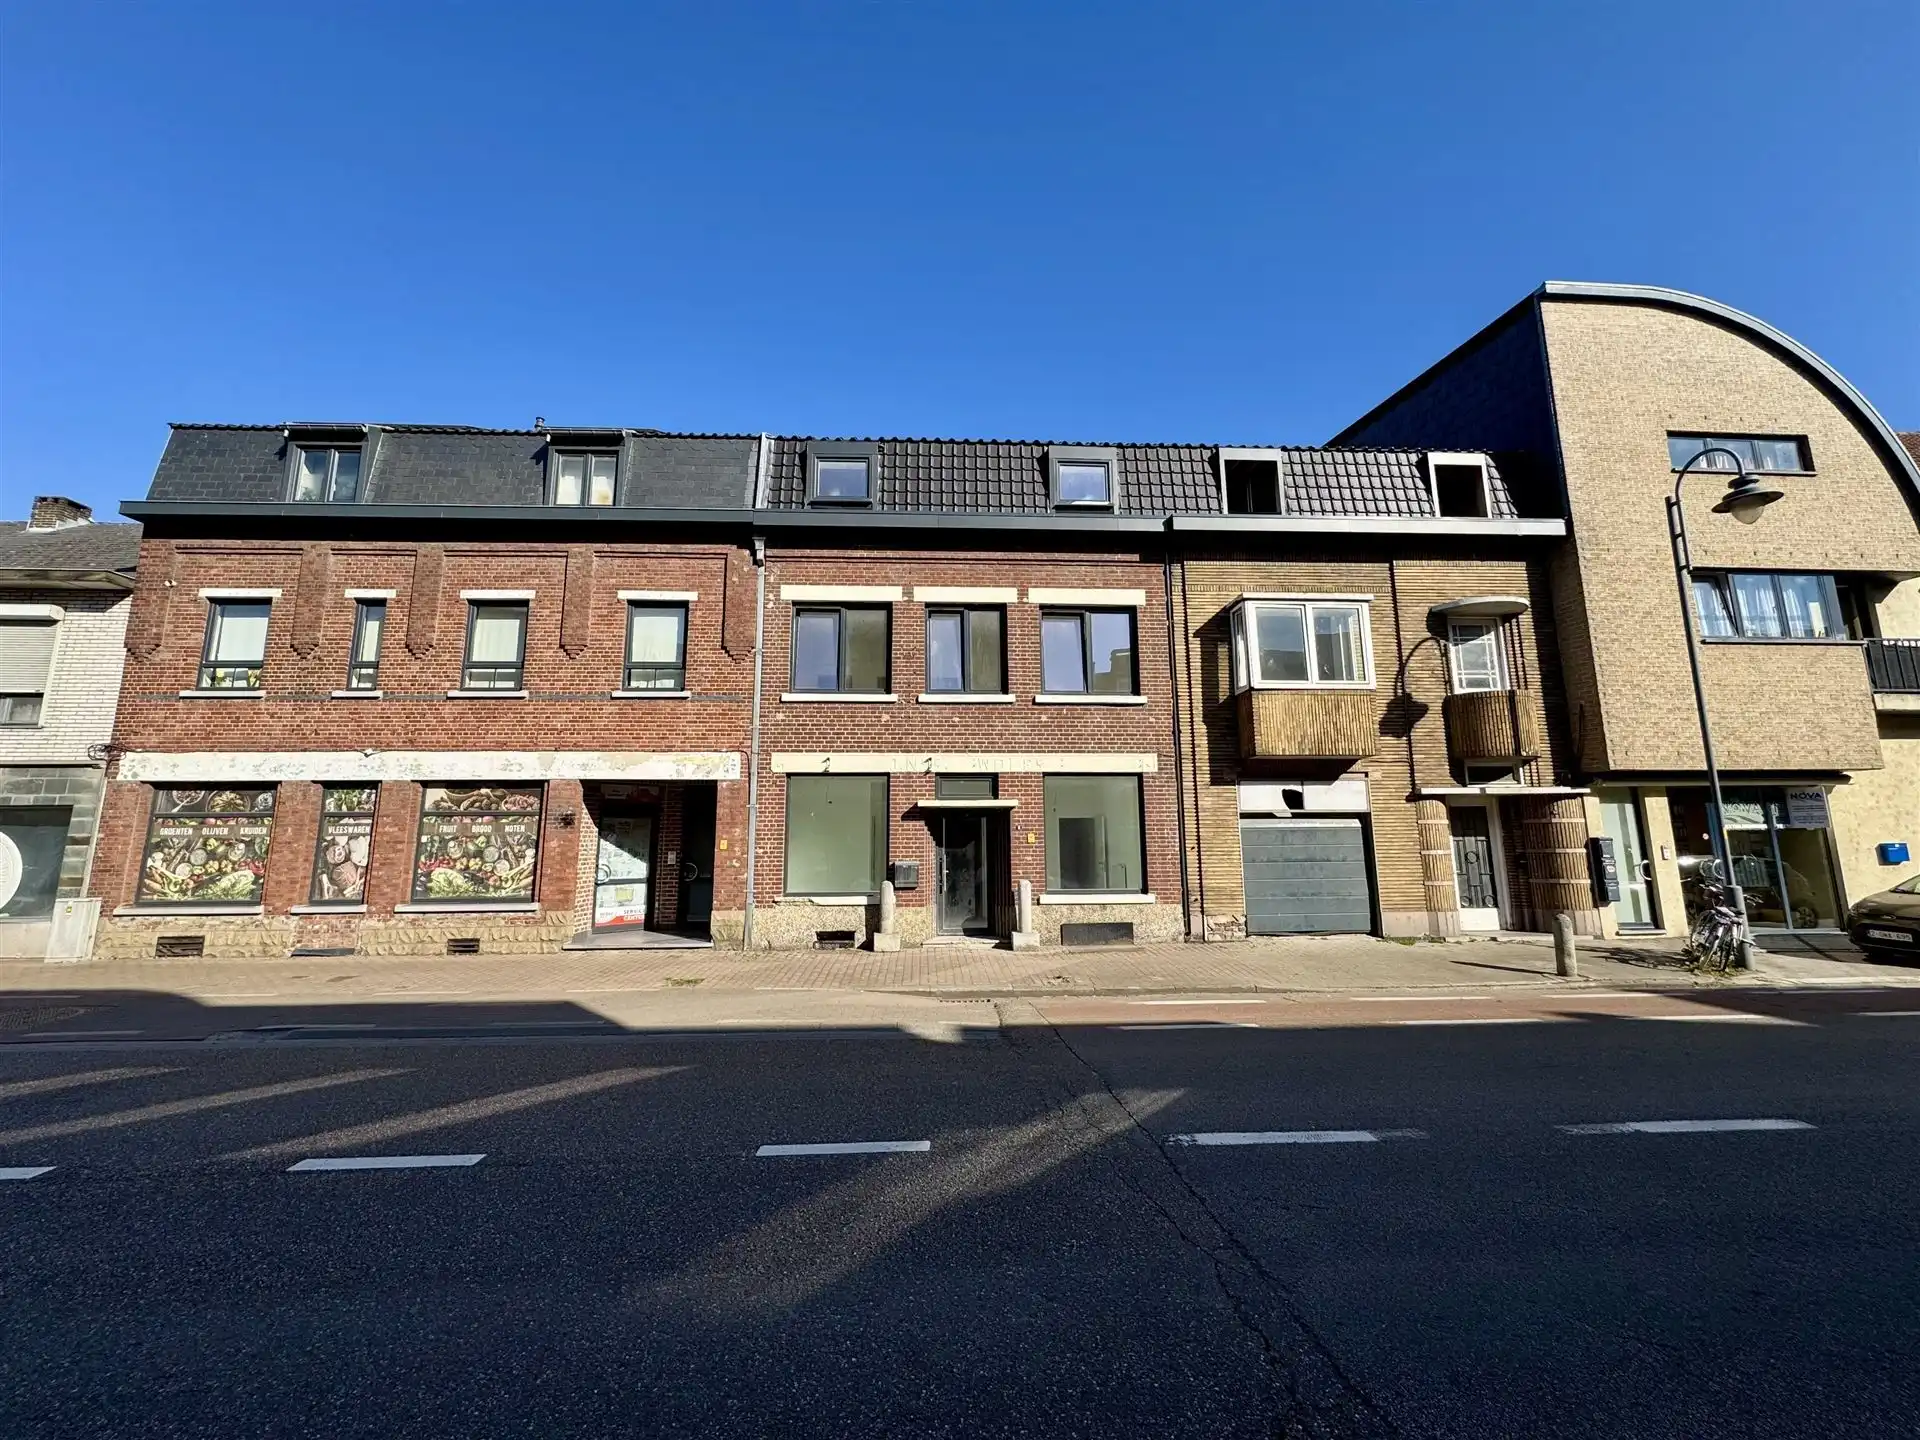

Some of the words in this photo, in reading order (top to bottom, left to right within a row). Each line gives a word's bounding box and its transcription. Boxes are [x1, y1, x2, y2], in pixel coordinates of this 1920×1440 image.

[1790, 791, 1823, 800] NOVA
[159, 827, 193, 835] GROENTEN
[201, 827, 229, 835] OLIJVEN
[239, 827, 267, 835] KRUIDEN
[328, 825, 370, 834] VLEESWAREN
[439, 825, 458, 833] FRUIT
[471, 825, 493, 833] BROOD
[504, 824, 526, 833] NOTEN
